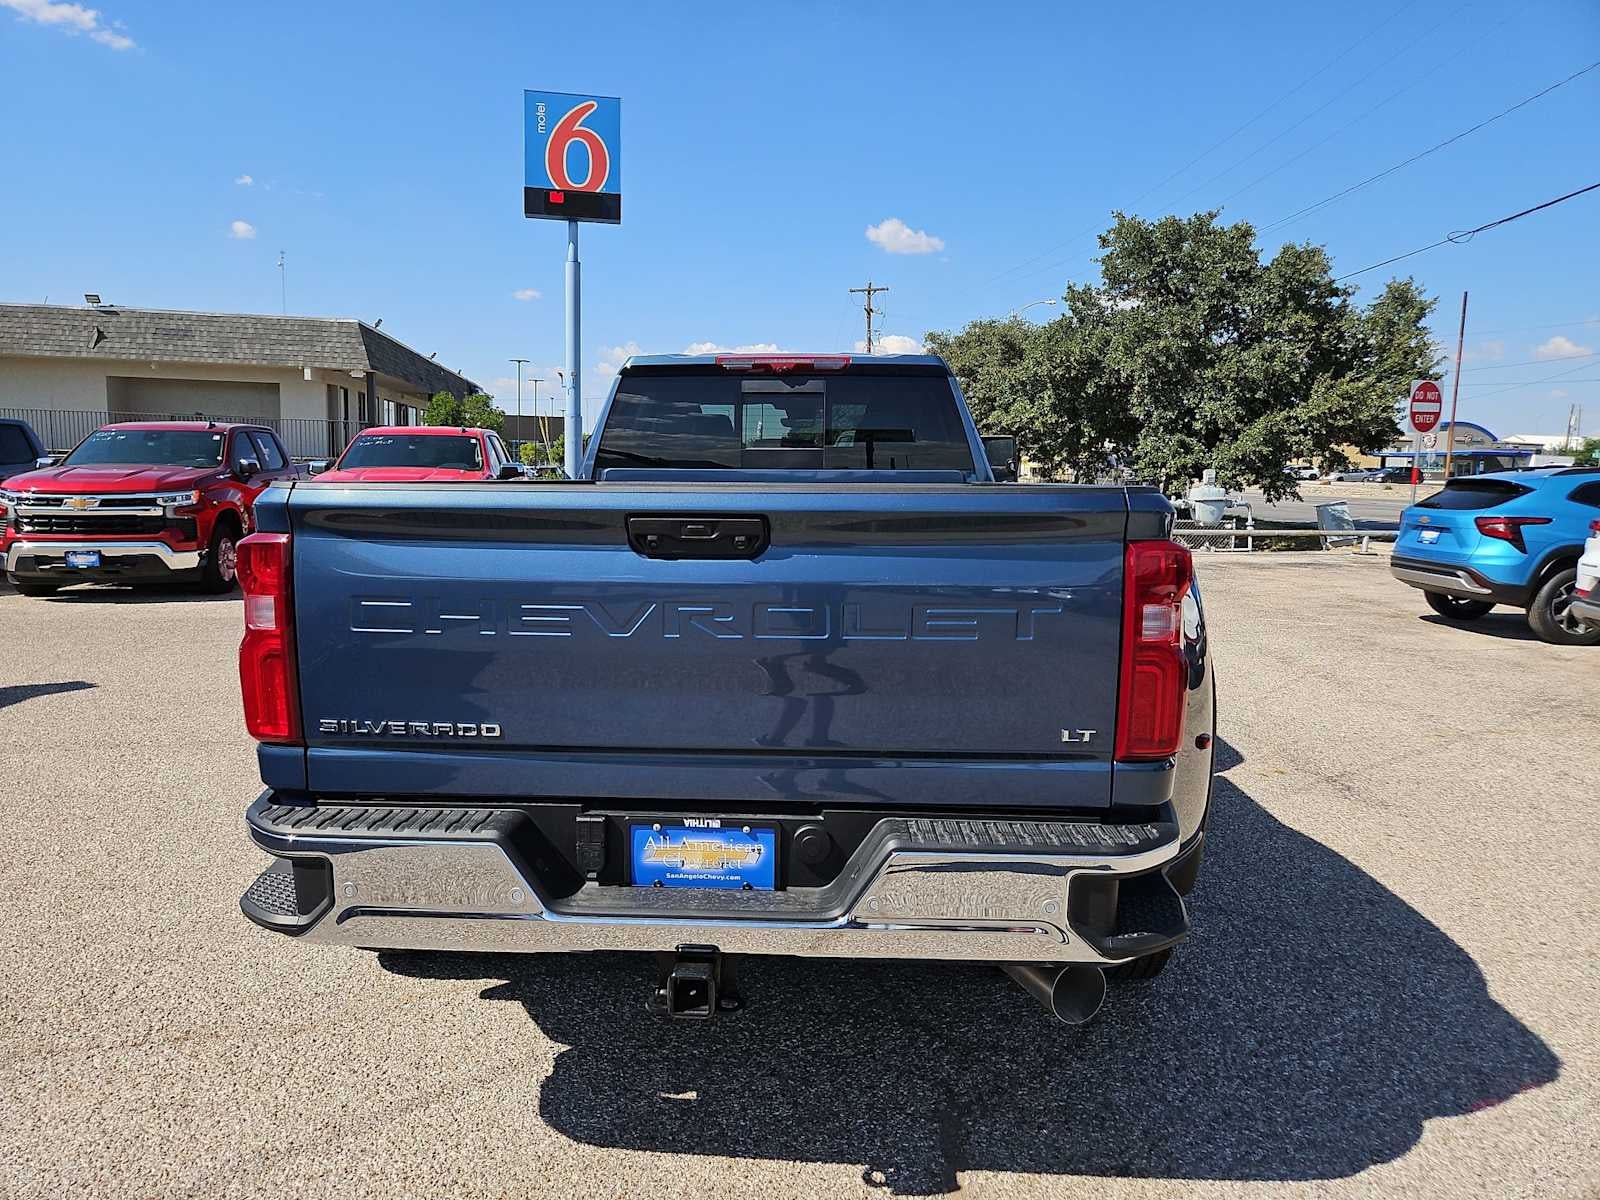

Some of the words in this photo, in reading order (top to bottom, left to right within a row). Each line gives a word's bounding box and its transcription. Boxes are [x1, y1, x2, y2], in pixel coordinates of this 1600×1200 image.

[535, 102, 546, 133] motel
[545, 100, 610, 192] 6
[1415, 391, 1424, 400] DO
[1426, 391, 1438, 400] NOT
[1415, 414, 1435, 424] ENTER
[350, 597, 1063, 642] CHEVROLET
[319, 718, 502, 737] SILVERADO
[1061, 729, 1096, 742] LT
[643, 836, 670, 851] All
[678, 836, 765, 853] American
[663, 852, 744, 870] Chevrolet
[666, 872, 741, 881] SanAngeloChevy.com
